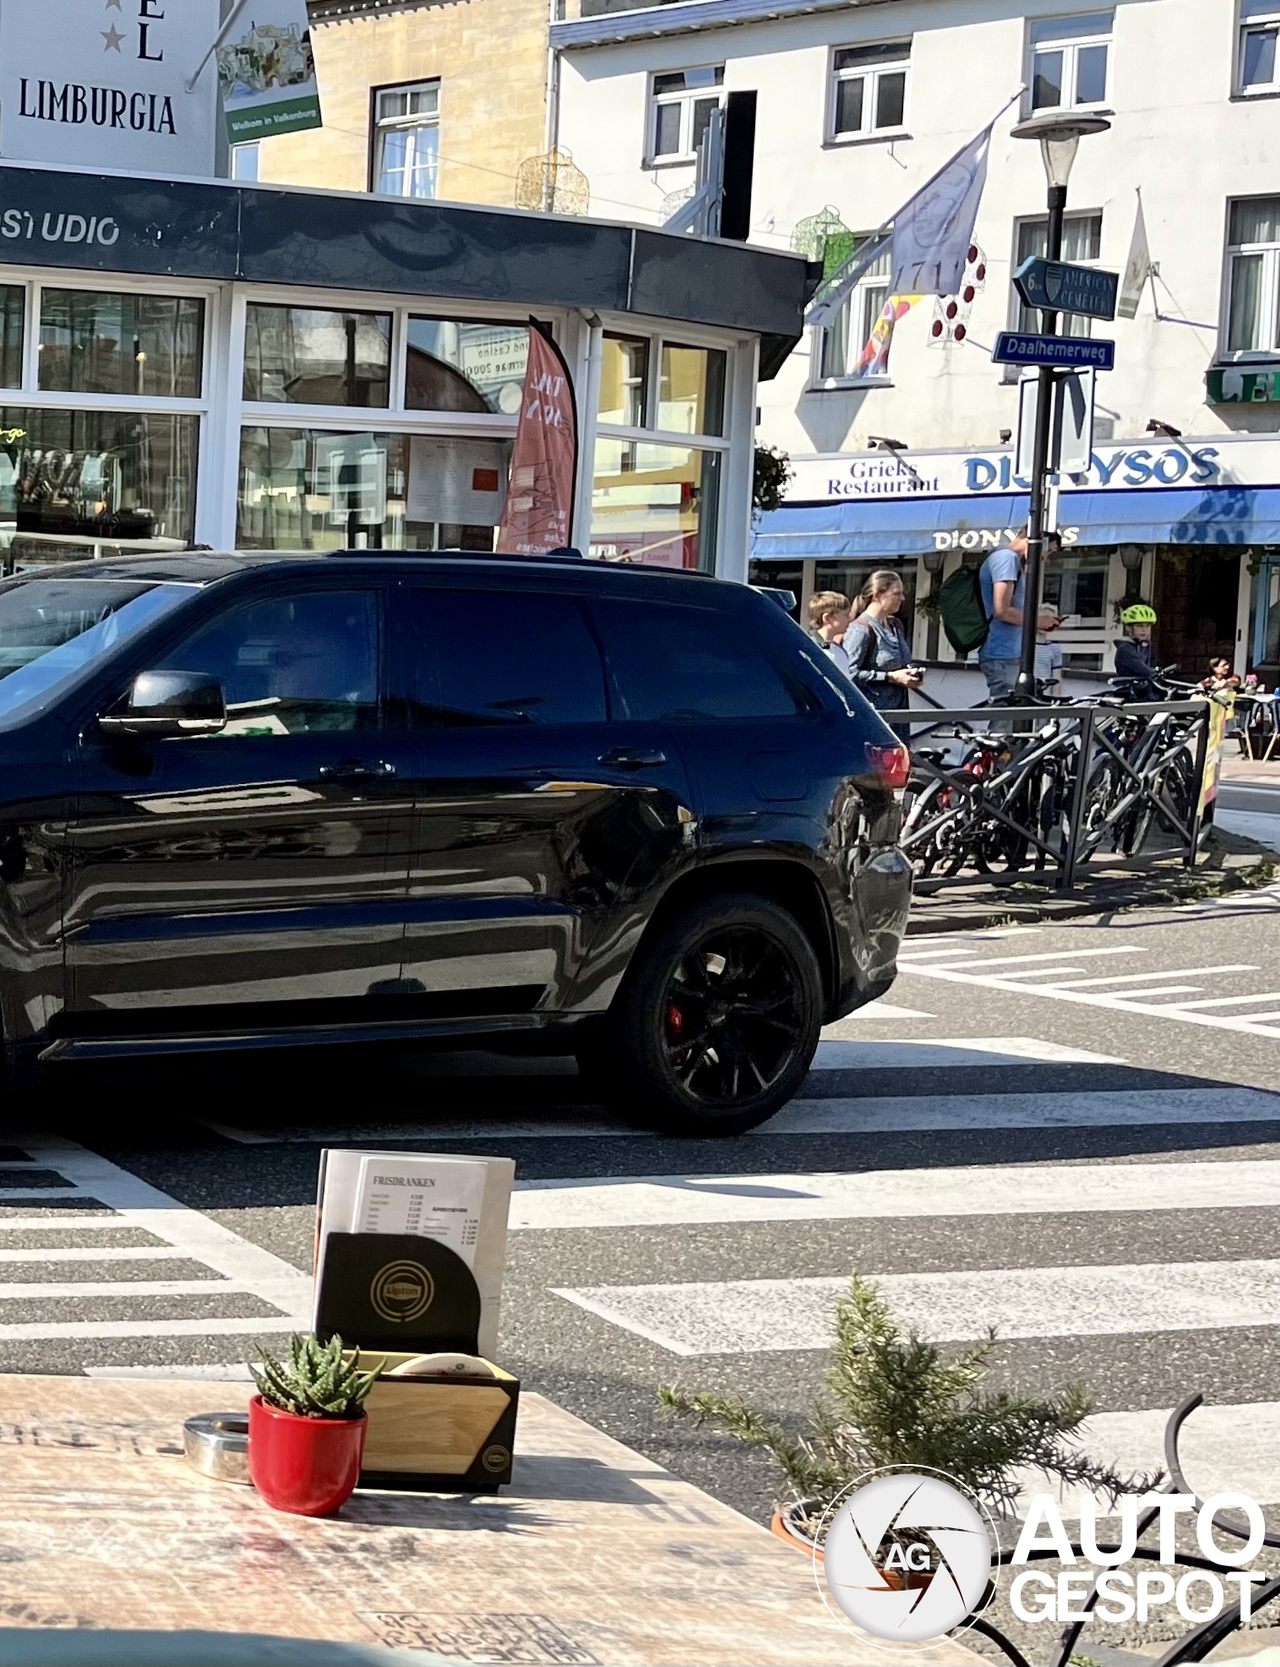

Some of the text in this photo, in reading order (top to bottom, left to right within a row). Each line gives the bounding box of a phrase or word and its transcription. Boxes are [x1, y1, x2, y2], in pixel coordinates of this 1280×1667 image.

[19, 77, 177, 135] LIMBURGIA
[232, 110, 317, 131] Welkom in Valkenburg
[1064, 271, 1114, 292] AMERICAN
[1006, 338, 1106, 363] Daalhemerweg
[850, 446, 1220, 491] Grieks DIYSOS
[827, 476, 940, 495] Restaurant
[372, 1175, 437, 1188] FRISDRANKEN
[386, 1286, 419, 1297] Lipton
